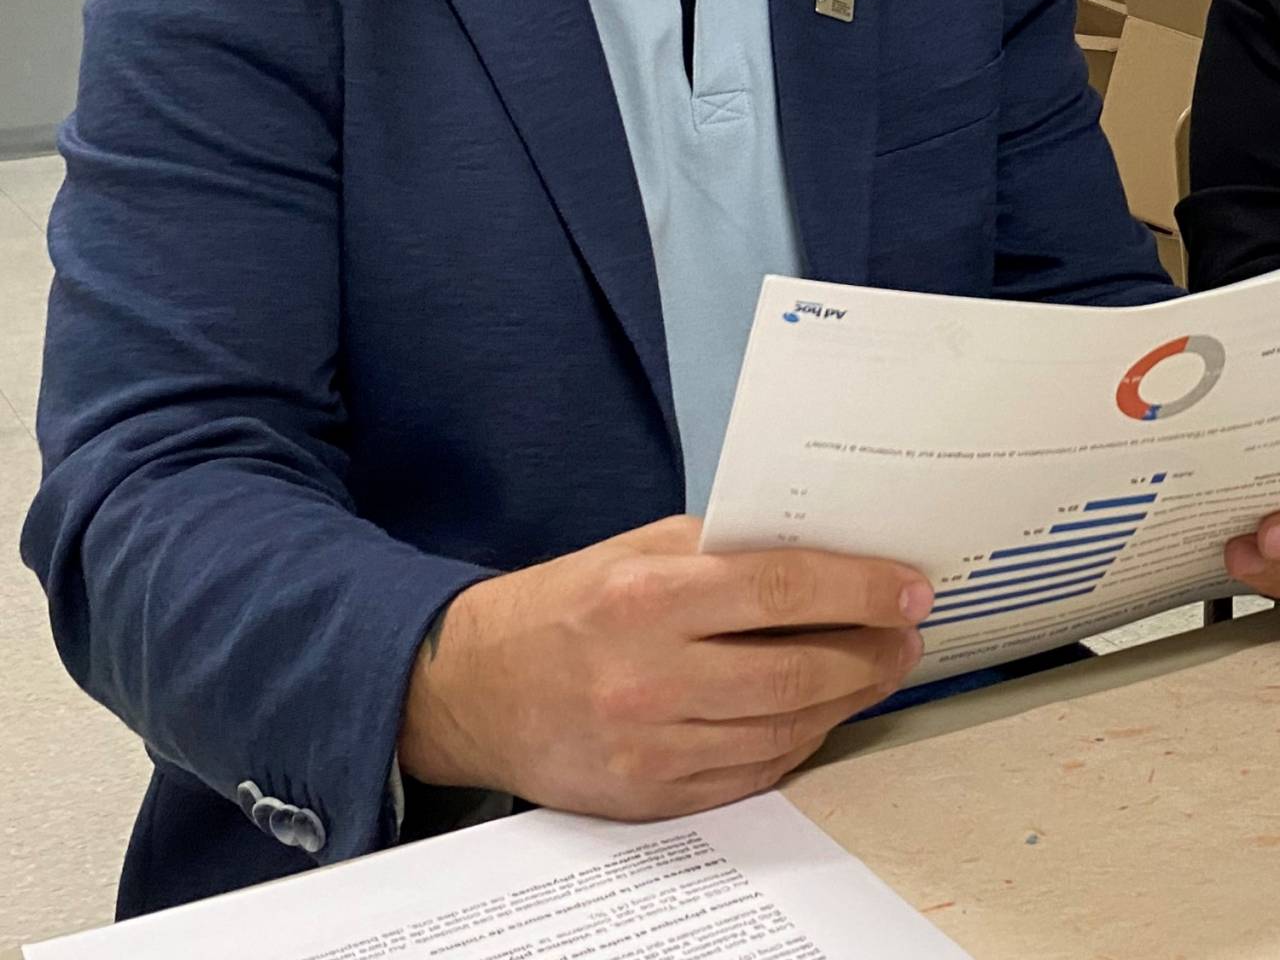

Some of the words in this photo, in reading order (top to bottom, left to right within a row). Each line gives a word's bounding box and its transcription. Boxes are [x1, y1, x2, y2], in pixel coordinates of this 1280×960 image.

[794, 306, 822, 318] hoc
[824, 308, 848, 320] Ad
[705, 858, 727, 869] Les
[710, 892, 763, 912] Violence
